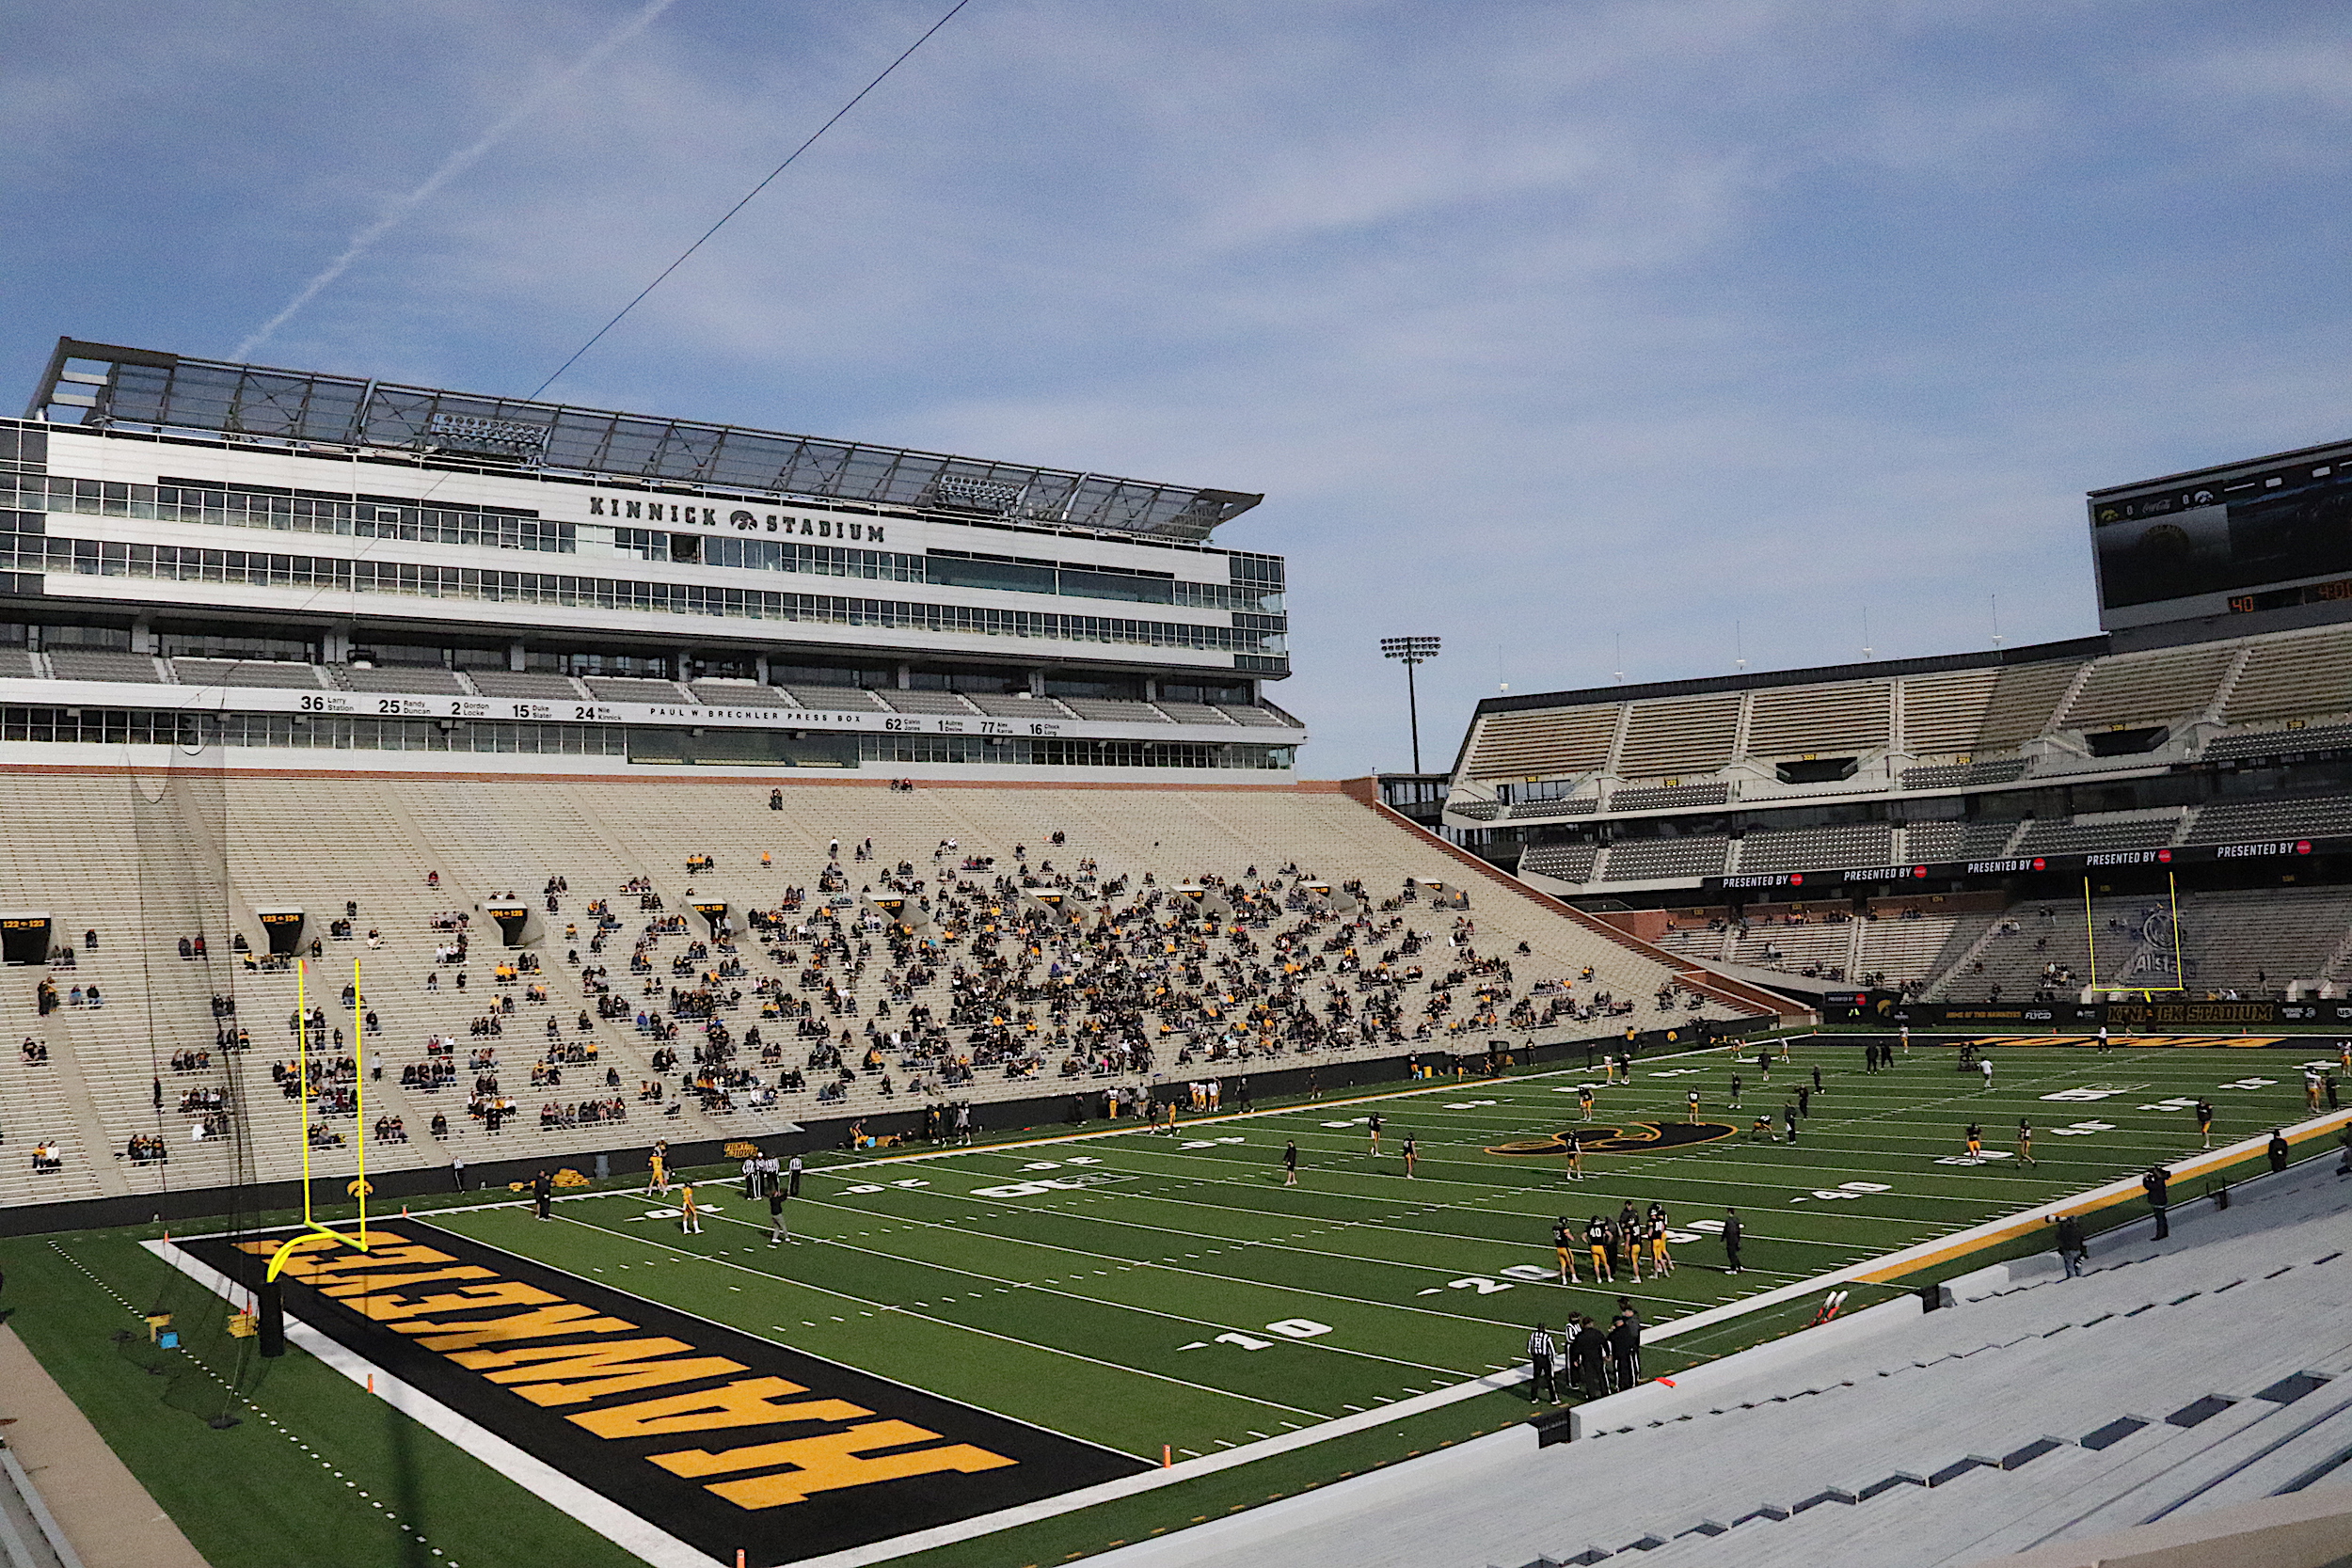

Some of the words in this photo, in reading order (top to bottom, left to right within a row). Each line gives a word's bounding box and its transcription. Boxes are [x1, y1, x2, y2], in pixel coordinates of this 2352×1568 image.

[591, 497, 716, 526] KINNICK
[767, 515, 884, 542] STADIUM
[2232, 596, 2254, 612] 40
[301, 696, 324, 711] 36
[327, 697, 346, 705] Larry
[378, 699, 400, 713] 25
[404, 700, 426, 709] Randy
[451, 702, 461, 715] 2
[513, 705, 530, 718] 15
[575, 706, 595, 720] 24
[650, 708, 684, 717] PAUL
[709, 711, 778, 720] BRECHLER
[787, 713, 828, 722] PRESS
[885, 718, 902, 731] 62
[938, 720, 944, 732] 1
[980, 721, 995, 733] 77
[1029, 724, 1042, 735] 16
[2217, 843, 2276, 858] PRESENTED
[2280, 842, 2294, 854] BY
[2087, 853, 2140, 866] PRESENTED
[2143, 851, 2156, 863] BY
[1968, 861, 2017, 873] PRESENTED
[2019, 860, 2031, 871] BY
[1844, 868, 1896, 881] PRESENTED
[1899, 867, 1912, 878] BY
[1723, 875, 1773, 888] PRESENTED
[1776, 875, 1788, 885] BY
[2186, 1005, 2273, 1022] STADIUM
[1812, 1181, 1893, 1200] 40
[1589, 1227, 1602, 1237] 40
[1447, 1264, 1560, 1295] 20
[1214, 1319, 1334, 1351] 10
[230, 1230, 1019, 1510] HAWKEYES
